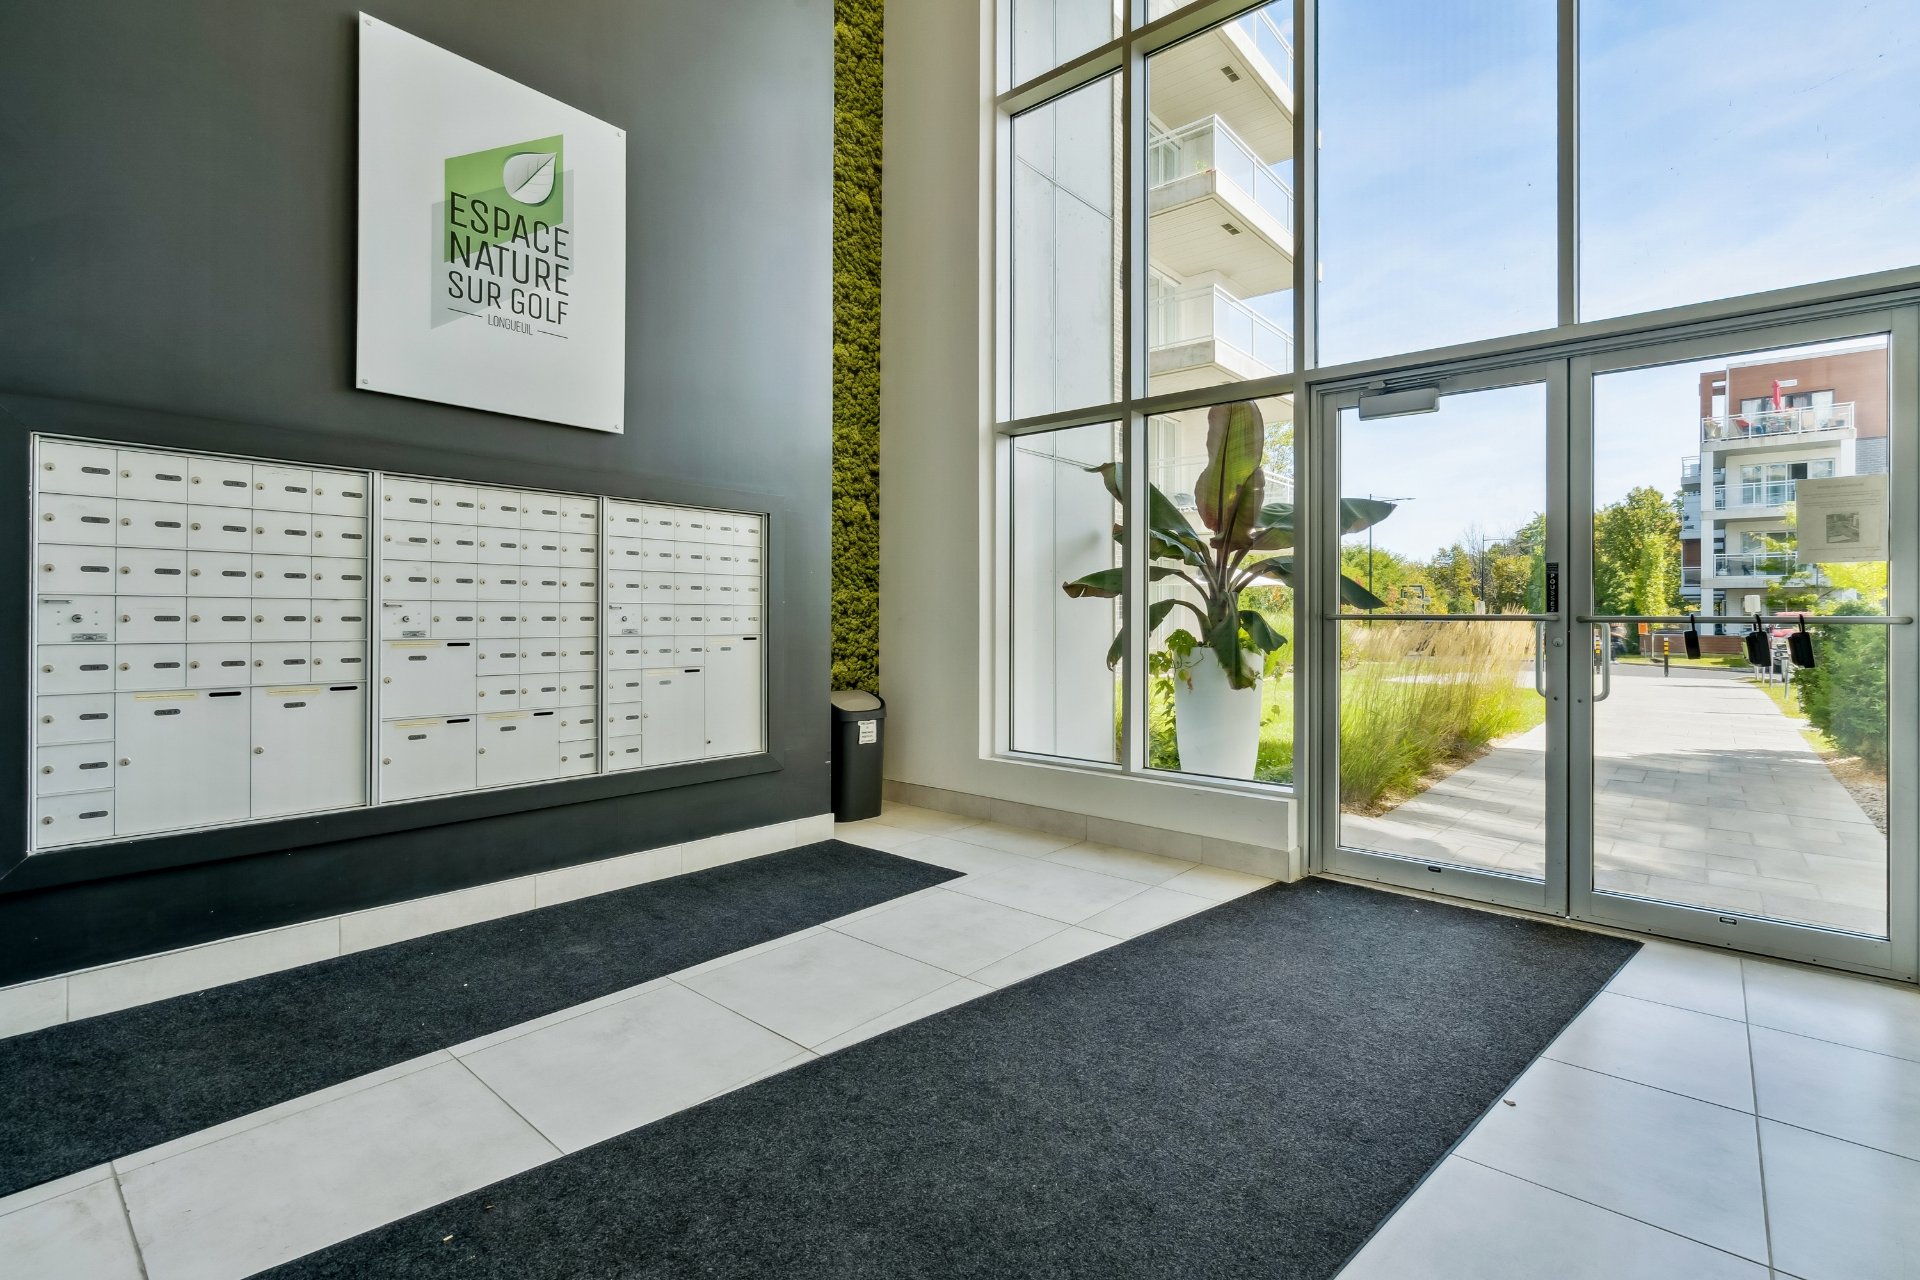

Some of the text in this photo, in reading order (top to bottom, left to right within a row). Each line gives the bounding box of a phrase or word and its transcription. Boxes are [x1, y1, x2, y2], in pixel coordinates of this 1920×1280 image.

[450, 191, 570, 261] ESPACE
[450, 230, 570, 297] NATURE
[448, 270, 569, 325] SUR GOLF
[487, 313, 534, 336] LONGUEUIL
